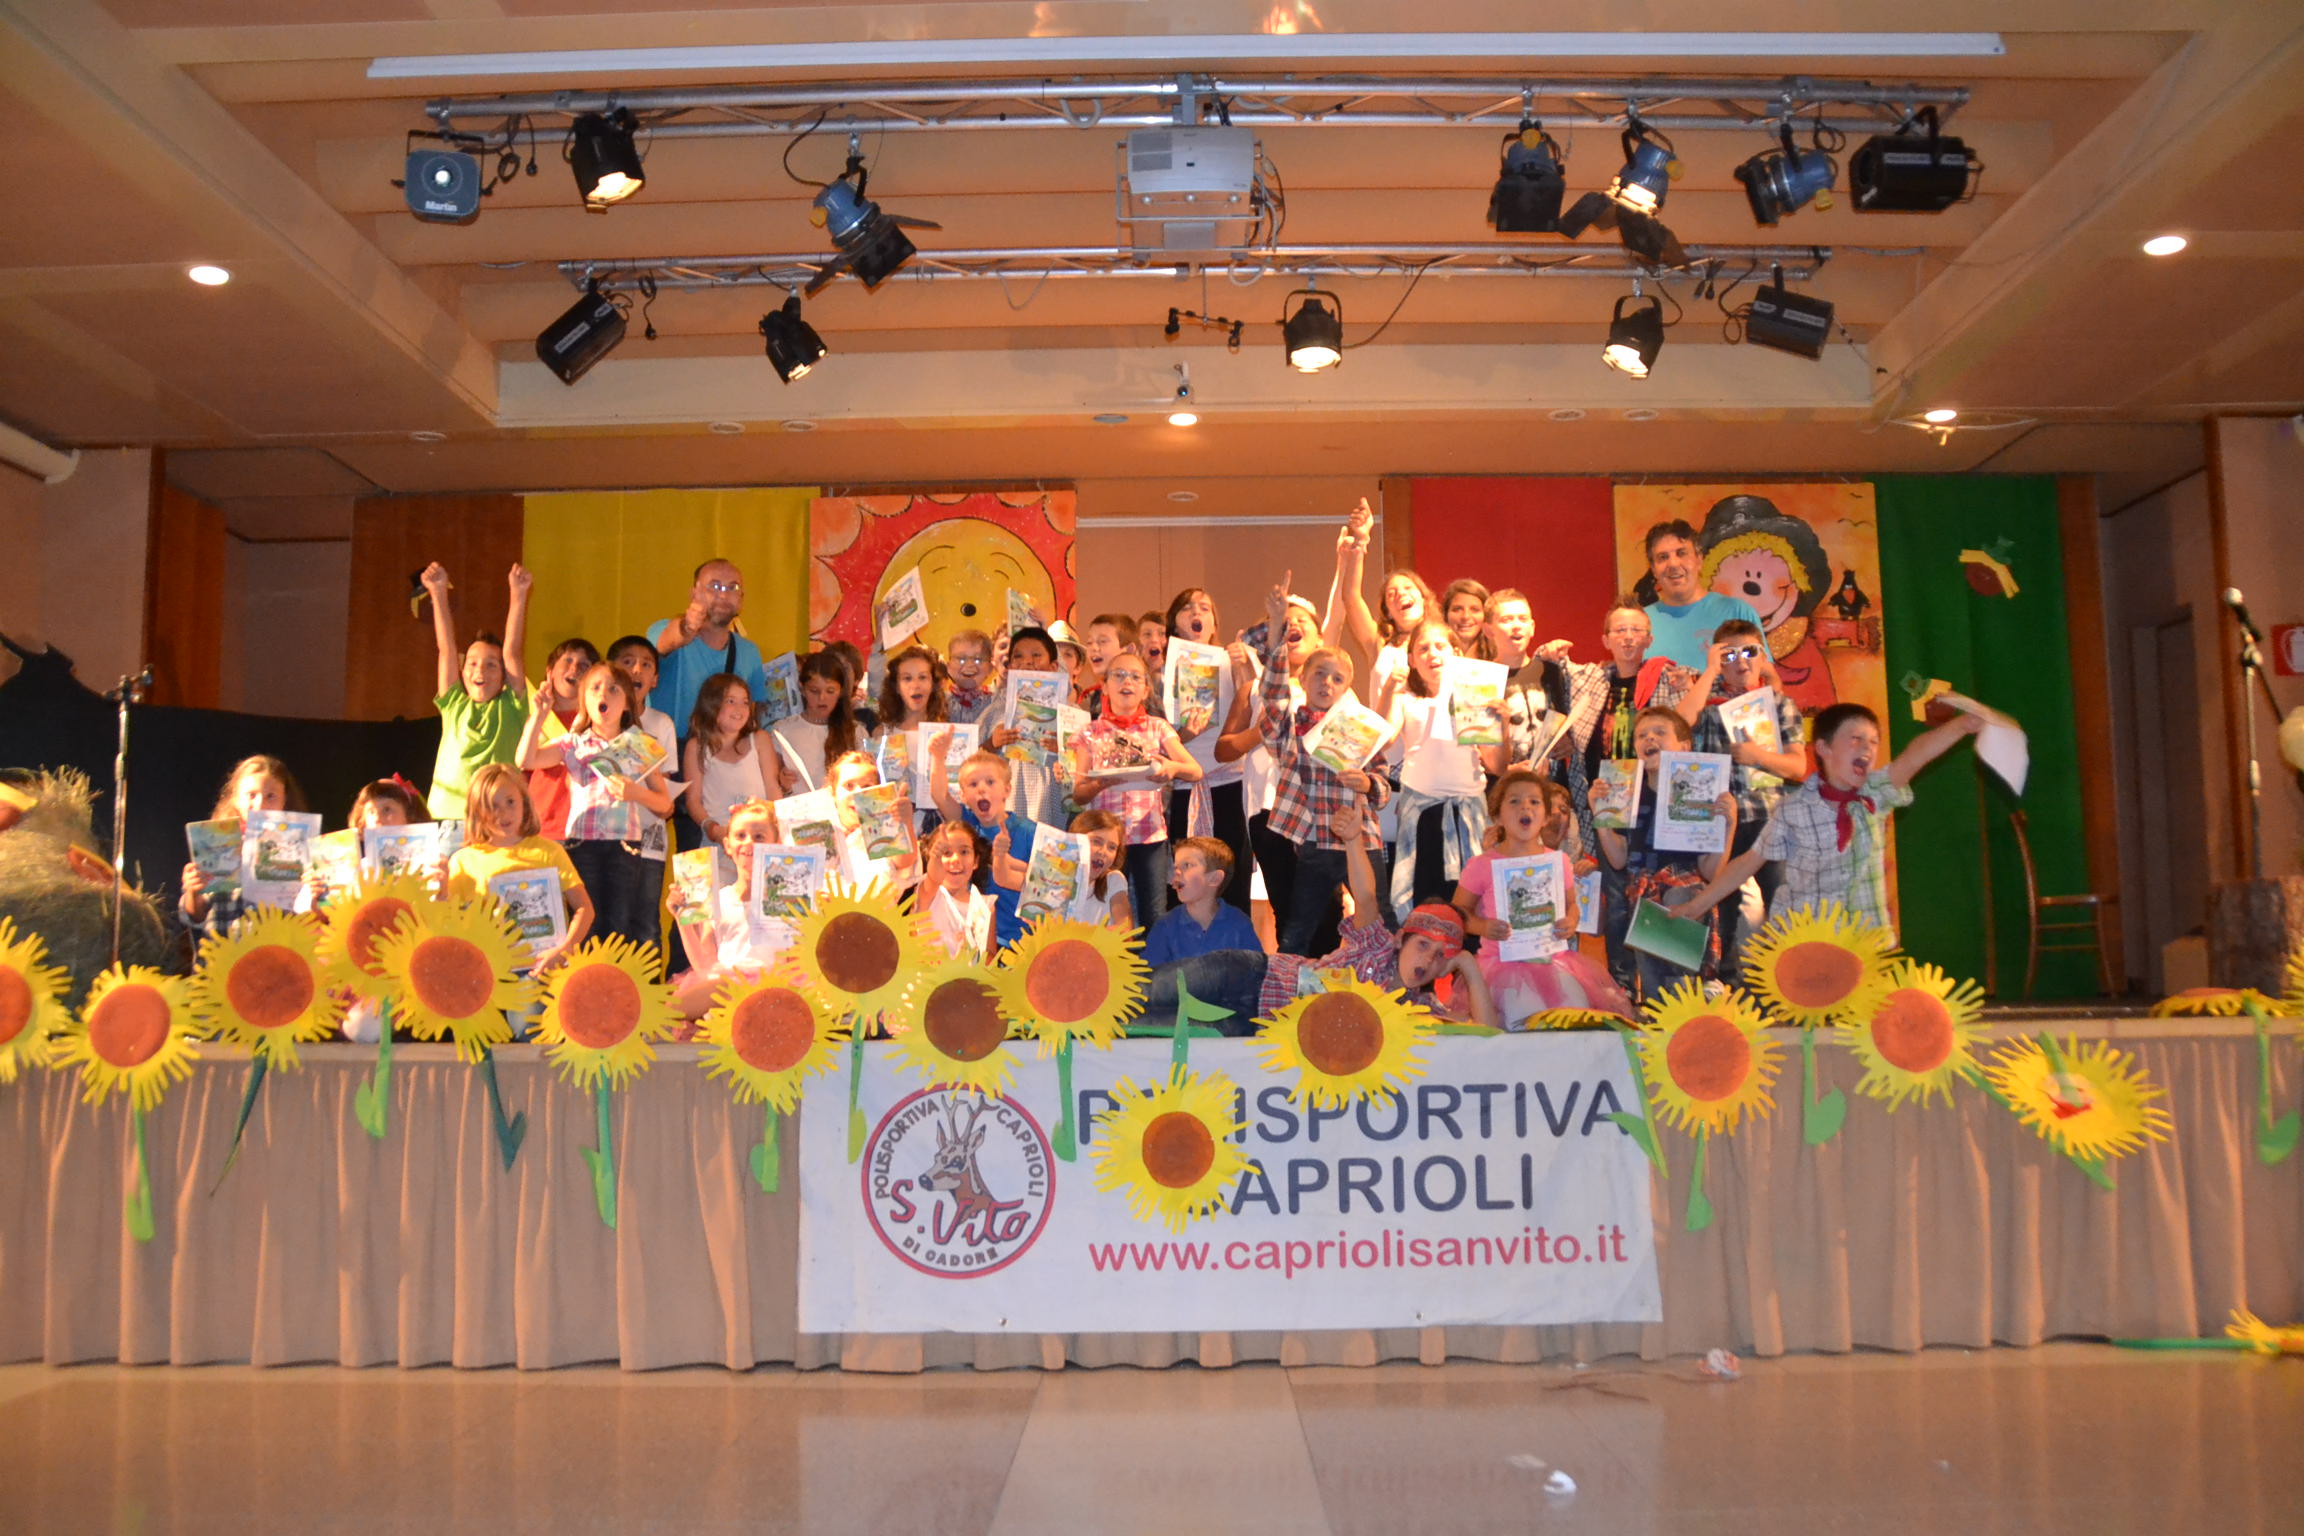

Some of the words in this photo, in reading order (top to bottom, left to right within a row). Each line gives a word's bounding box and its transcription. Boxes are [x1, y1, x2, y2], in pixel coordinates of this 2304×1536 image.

[1079, 1080, 1630, 1145] PISPORTIVA
[874, 1098, 940, 1200] POLISPORTIVA
[997, 1108, 1045, 1198] CAPRIOLI
[933, 1198, 1032, 1247] Vito
[902, 1235, 921, 1254] DI
[925, 1246, 999, 1267] CADORE
[1088, 1224, 1629, 1280] www.capriolisanvito.it
